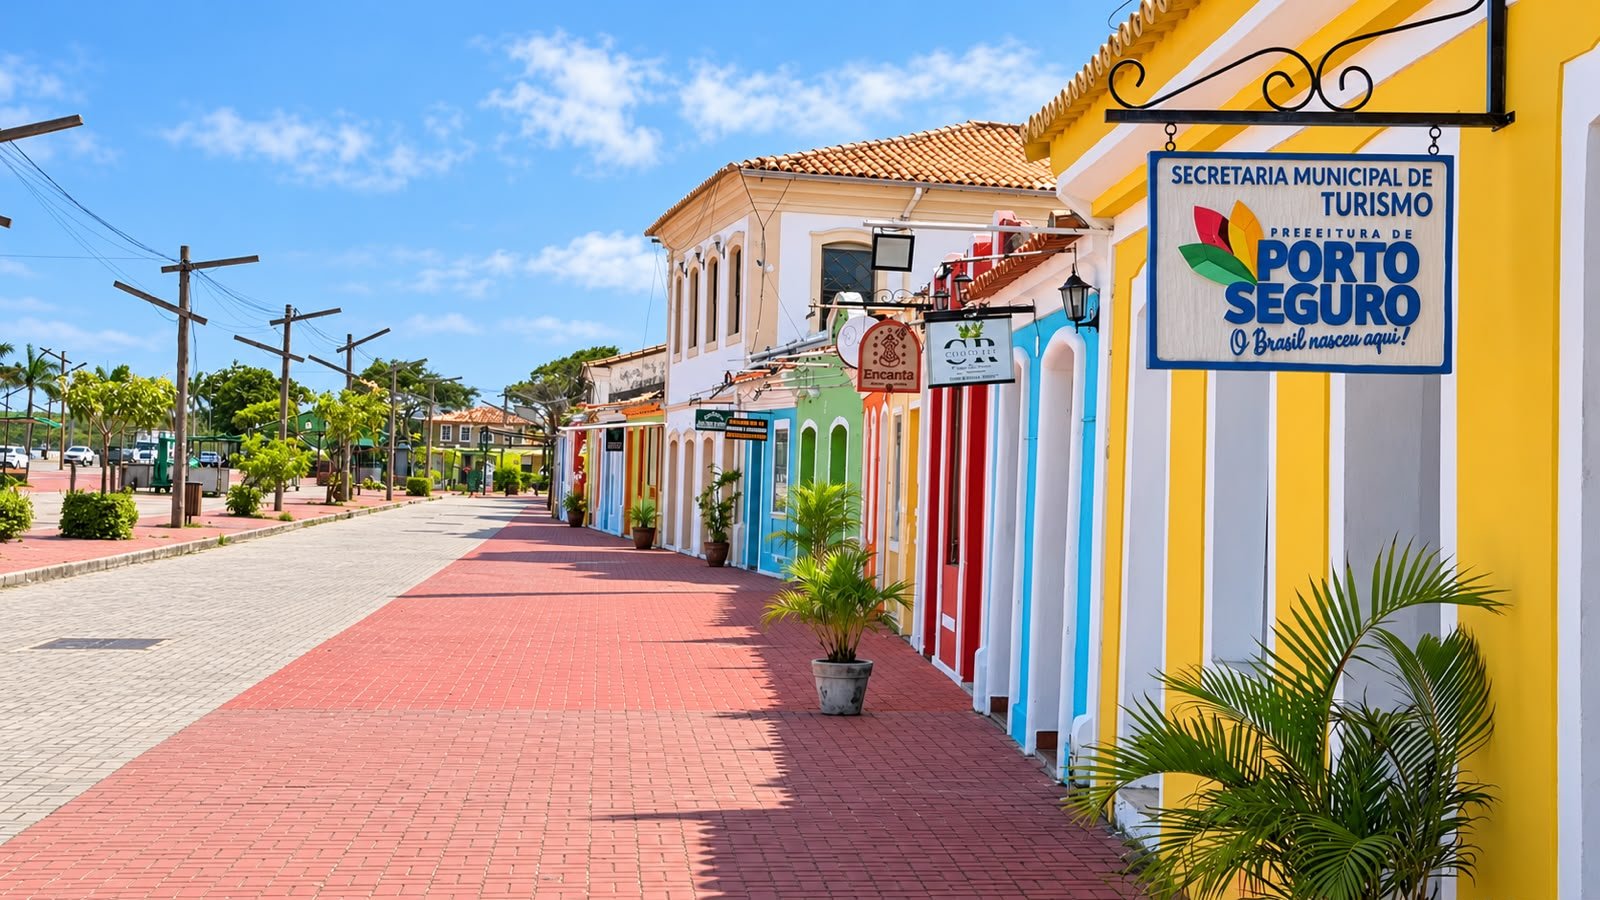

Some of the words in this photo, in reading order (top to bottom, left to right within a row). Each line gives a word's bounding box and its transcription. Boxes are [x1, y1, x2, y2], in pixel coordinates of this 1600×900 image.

[1171, 165, 1289, 186] SECRETARIA
[1293, 167, 1403, 187] MUNICIPAL
[1407, 168, 1433, 187] DE
[1321, 191, 1434, 218] TURISMO
[1392, 229, 1413, 240] DE
[1257, 239, 1420, 284] PORTO
[1223, 281, 1421, 327] SEGURO
[1230, 328, 1249, 356] O
[1253, 327, 1306, 356] Brasil
[1309, 334, 1361, 350] nasceu
[1363, 326, 1410, 355] aqui!
[863, 368, 914, 381] Encanta
